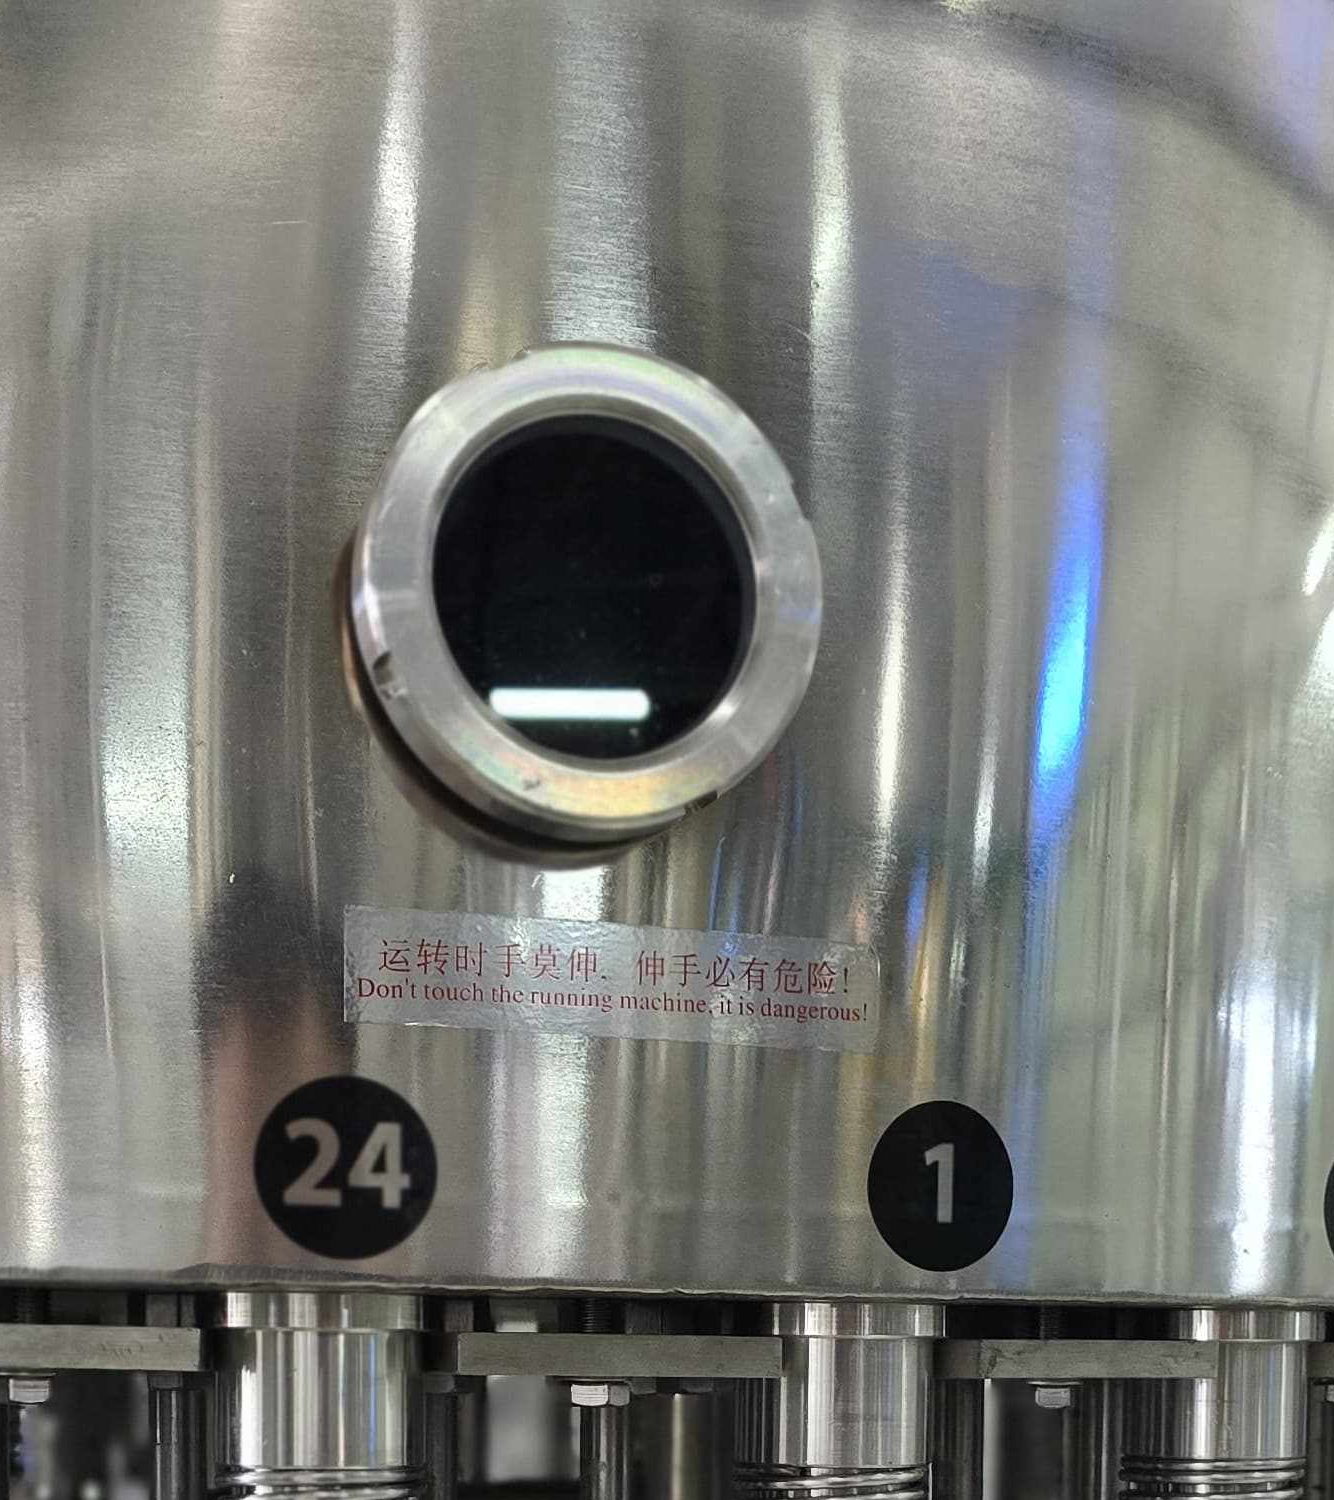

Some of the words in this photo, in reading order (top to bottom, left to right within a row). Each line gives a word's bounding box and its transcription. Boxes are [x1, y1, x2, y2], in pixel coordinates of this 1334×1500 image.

[357, 977, 418, 998] Don't
[424, 982, 484, 1002] touch
[491, 984, 524, 1004] the
[531, 987, 614, 1012] running
[620, 993, 714, 1015] machine,
[719, 994, 733, 1015] it
[739, 996, 755, 1016] is
[760, 999, 868, 1023] dangerous!
[283, 1117, 411, 1209] 24
[924, 1142, 955, 1224] 1
